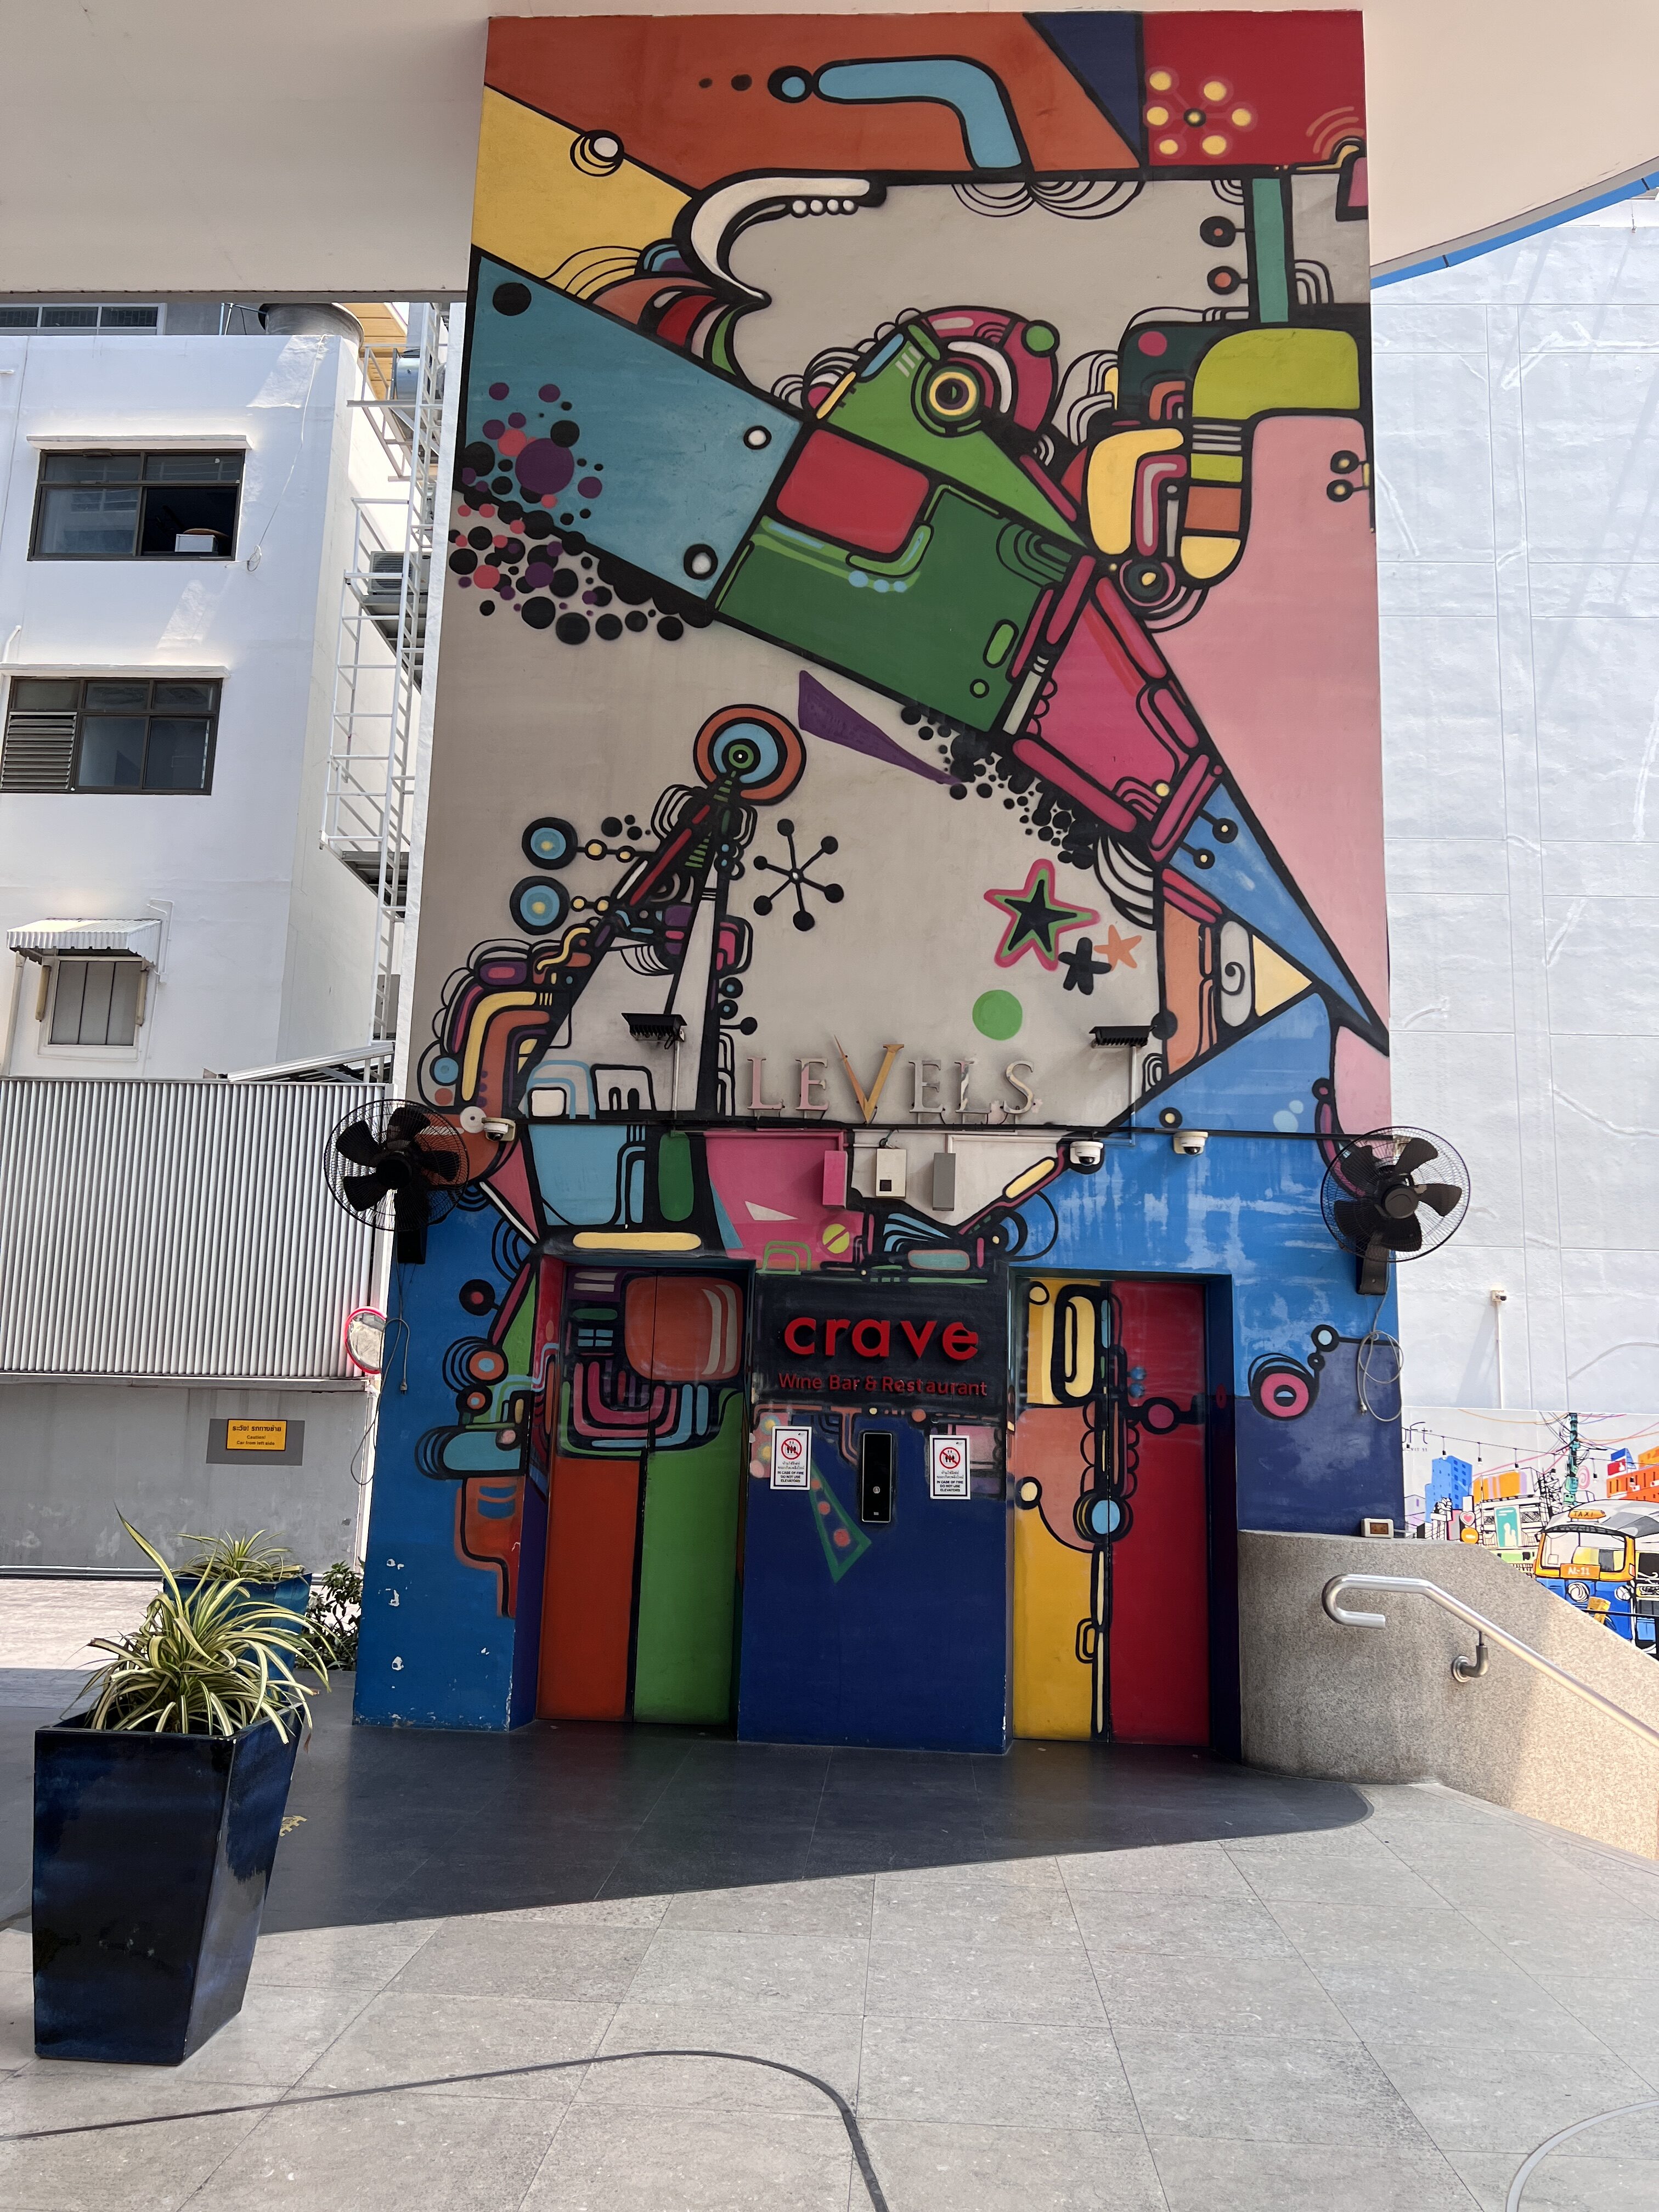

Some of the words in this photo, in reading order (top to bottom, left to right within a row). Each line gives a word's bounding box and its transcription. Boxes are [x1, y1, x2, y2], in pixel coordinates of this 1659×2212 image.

[747, 1035, 1035, 1124] LEVELS
[784, 1317, 979, 1361] crave
[778, 1373, 822, 1390] Wine
[829, 1374, 860, 1391] Bar
[865, 1375, 878, 1392] &
[882, 1375, 988, 1396] Restaurant
